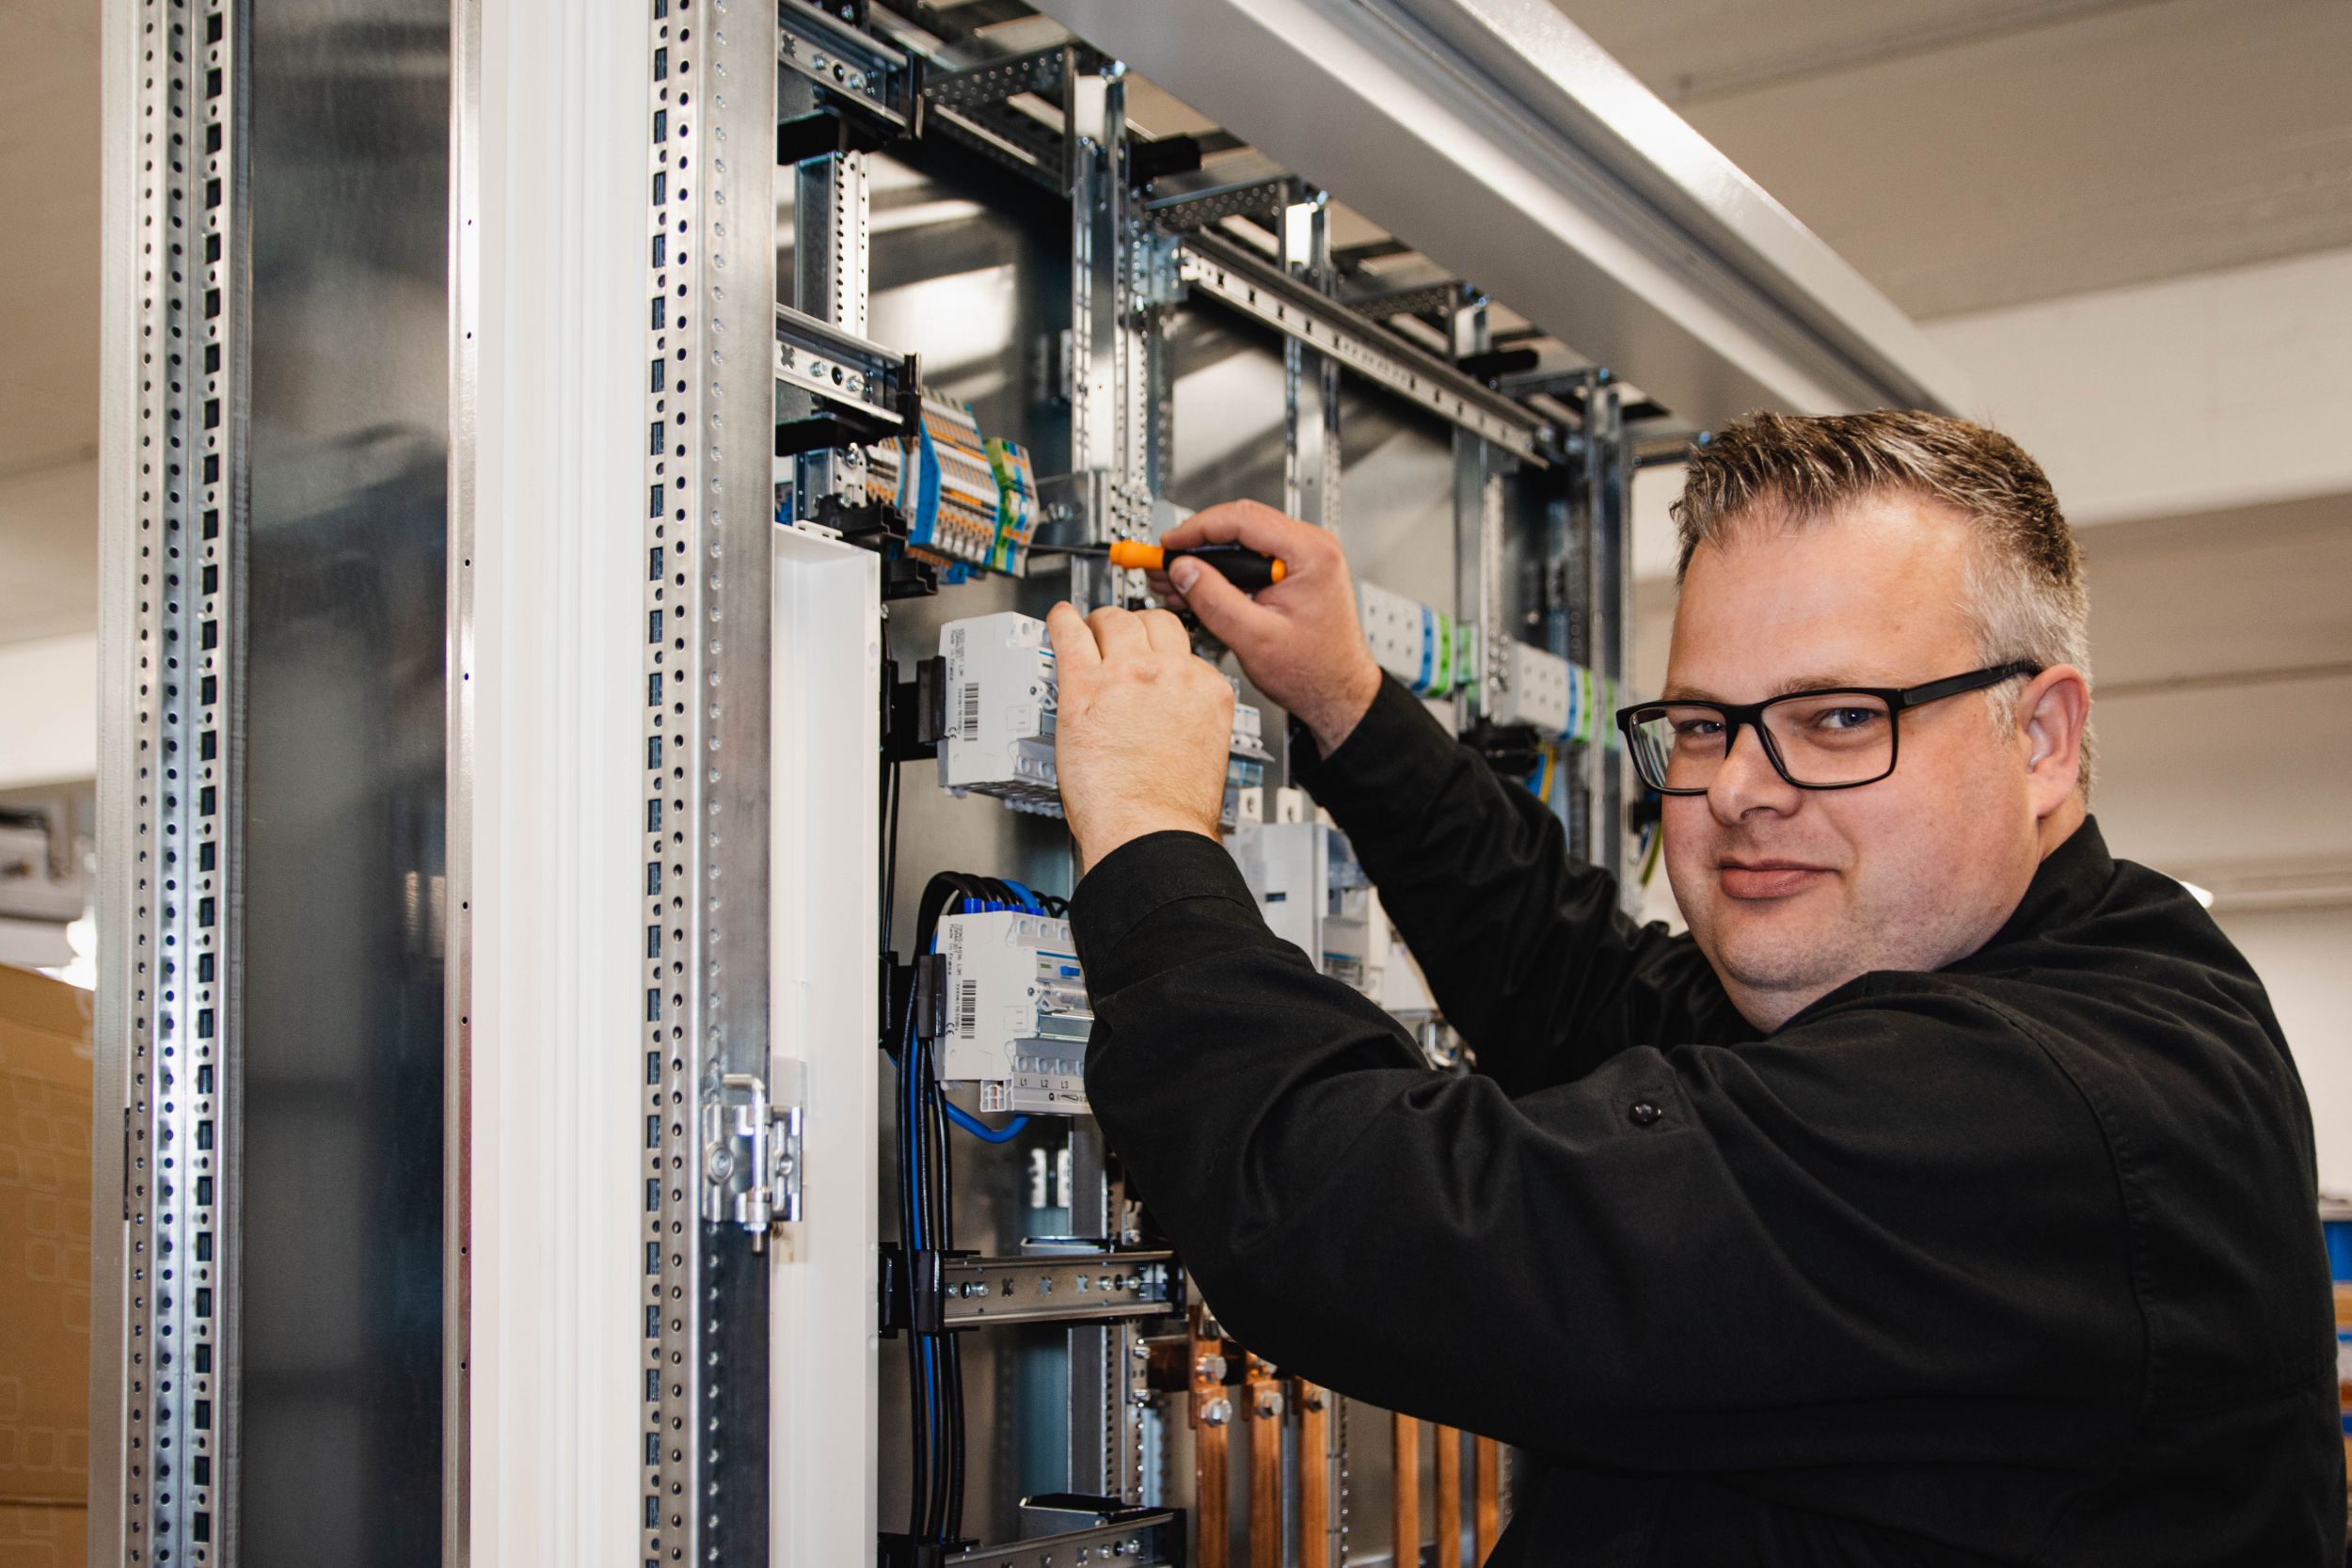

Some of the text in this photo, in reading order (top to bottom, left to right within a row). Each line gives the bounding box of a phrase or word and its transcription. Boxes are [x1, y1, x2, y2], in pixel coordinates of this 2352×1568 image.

[1020, 1077, 1069, 1089] L1 L2 L3
